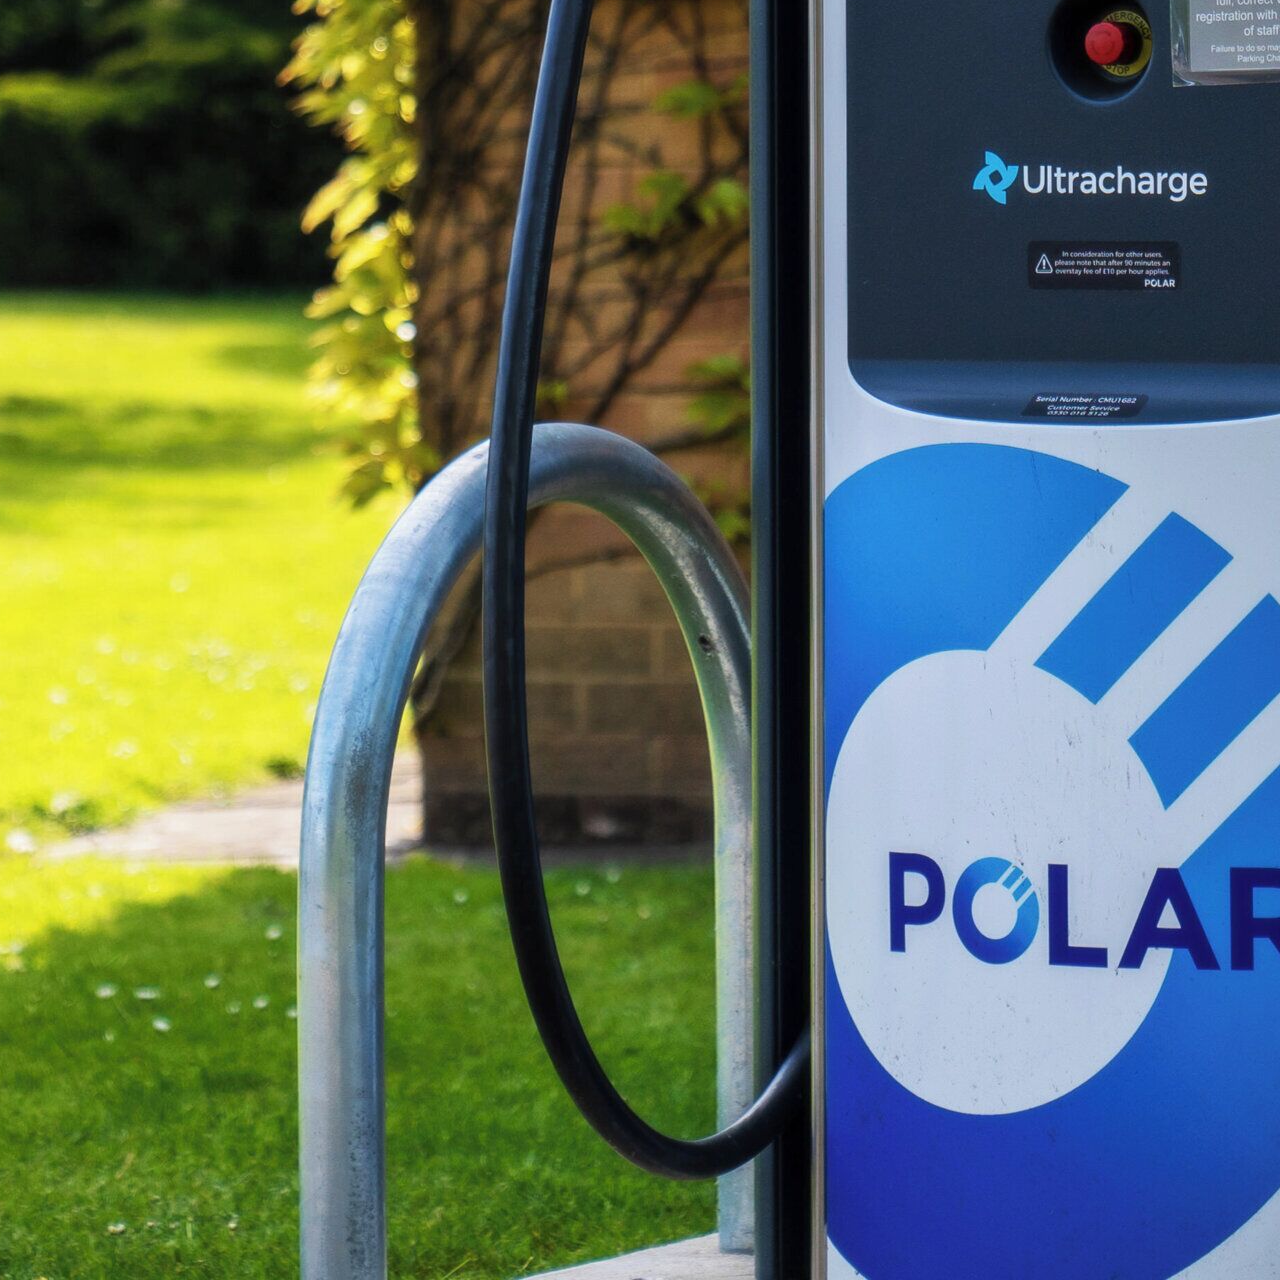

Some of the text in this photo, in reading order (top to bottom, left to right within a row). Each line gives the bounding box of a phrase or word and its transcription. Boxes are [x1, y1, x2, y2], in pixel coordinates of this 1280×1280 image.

[1196, 11, 1253, 24] registration
[1256, 10, 1278, 20] with
[1244, 25, 1254, 36] of
[1211, 45, 1235, 53] Failure
[1237, 55, 1264, 63] Parking
[1023, 165, 1208, 202] Ultracharge
[1145, 268, 1169, 276] applies.
[1145, 279, 1175, 287] POLAR
